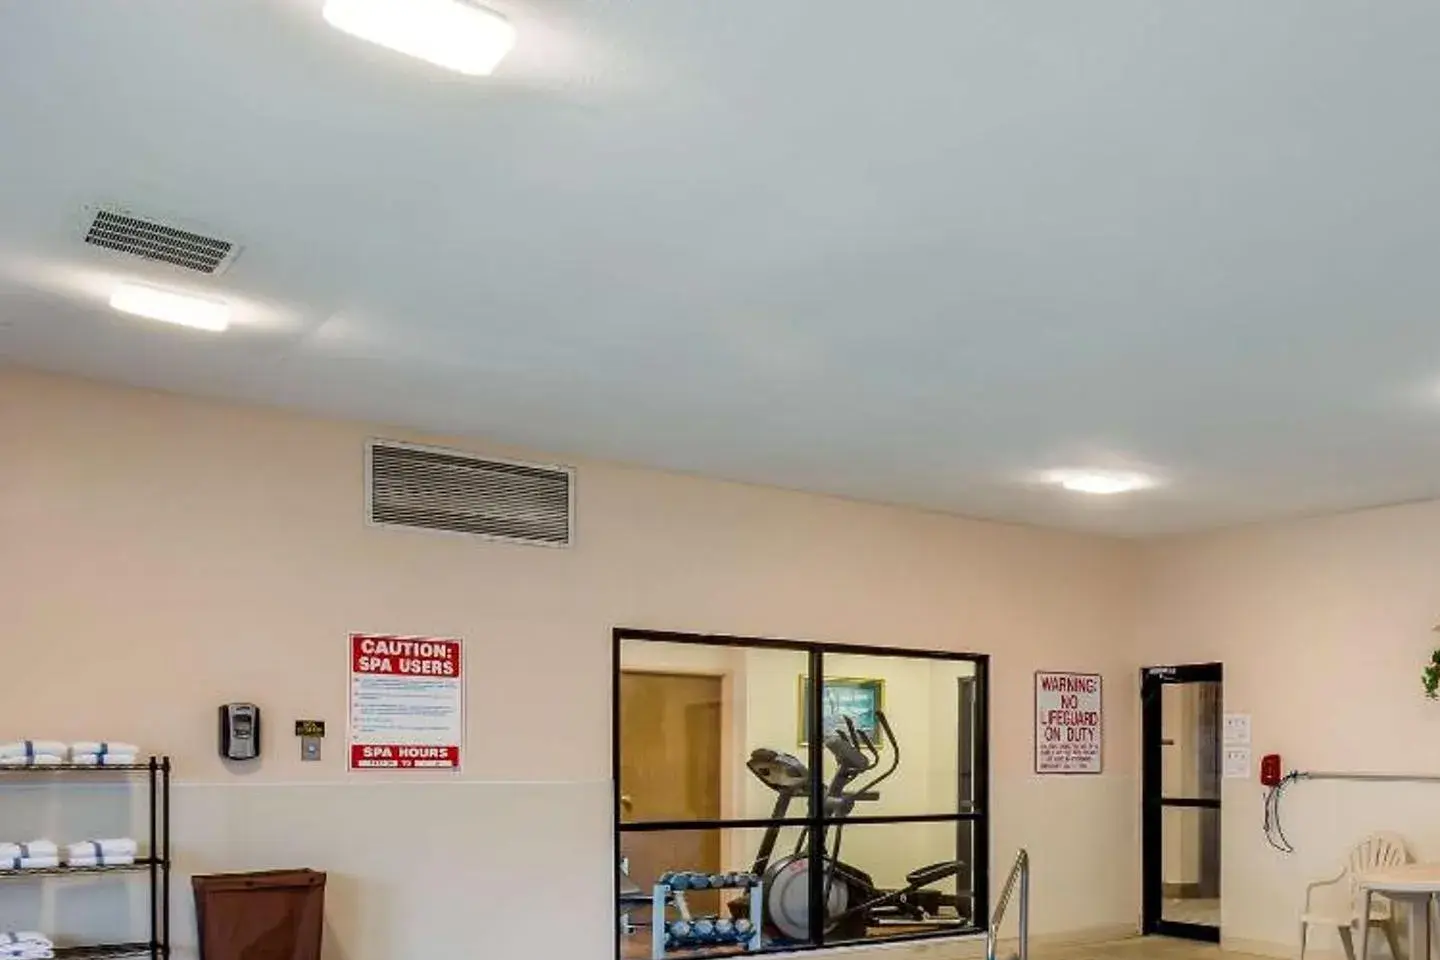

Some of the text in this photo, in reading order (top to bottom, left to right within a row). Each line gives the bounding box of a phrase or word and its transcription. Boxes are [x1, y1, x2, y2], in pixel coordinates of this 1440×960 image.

[361, 640, 452, 659] CAUTION:
[359, 657, 454, 675] SPA USERS
[1042, 677, 1097, 693] WARNING:
[1061, 694, 1078, 709] NO
[1041, 710, 1098, 726] LIFEGUARD
[1044, 727, 1095, 742] ON DUTY
[363, 747, 449, 759] SPA HOURS
